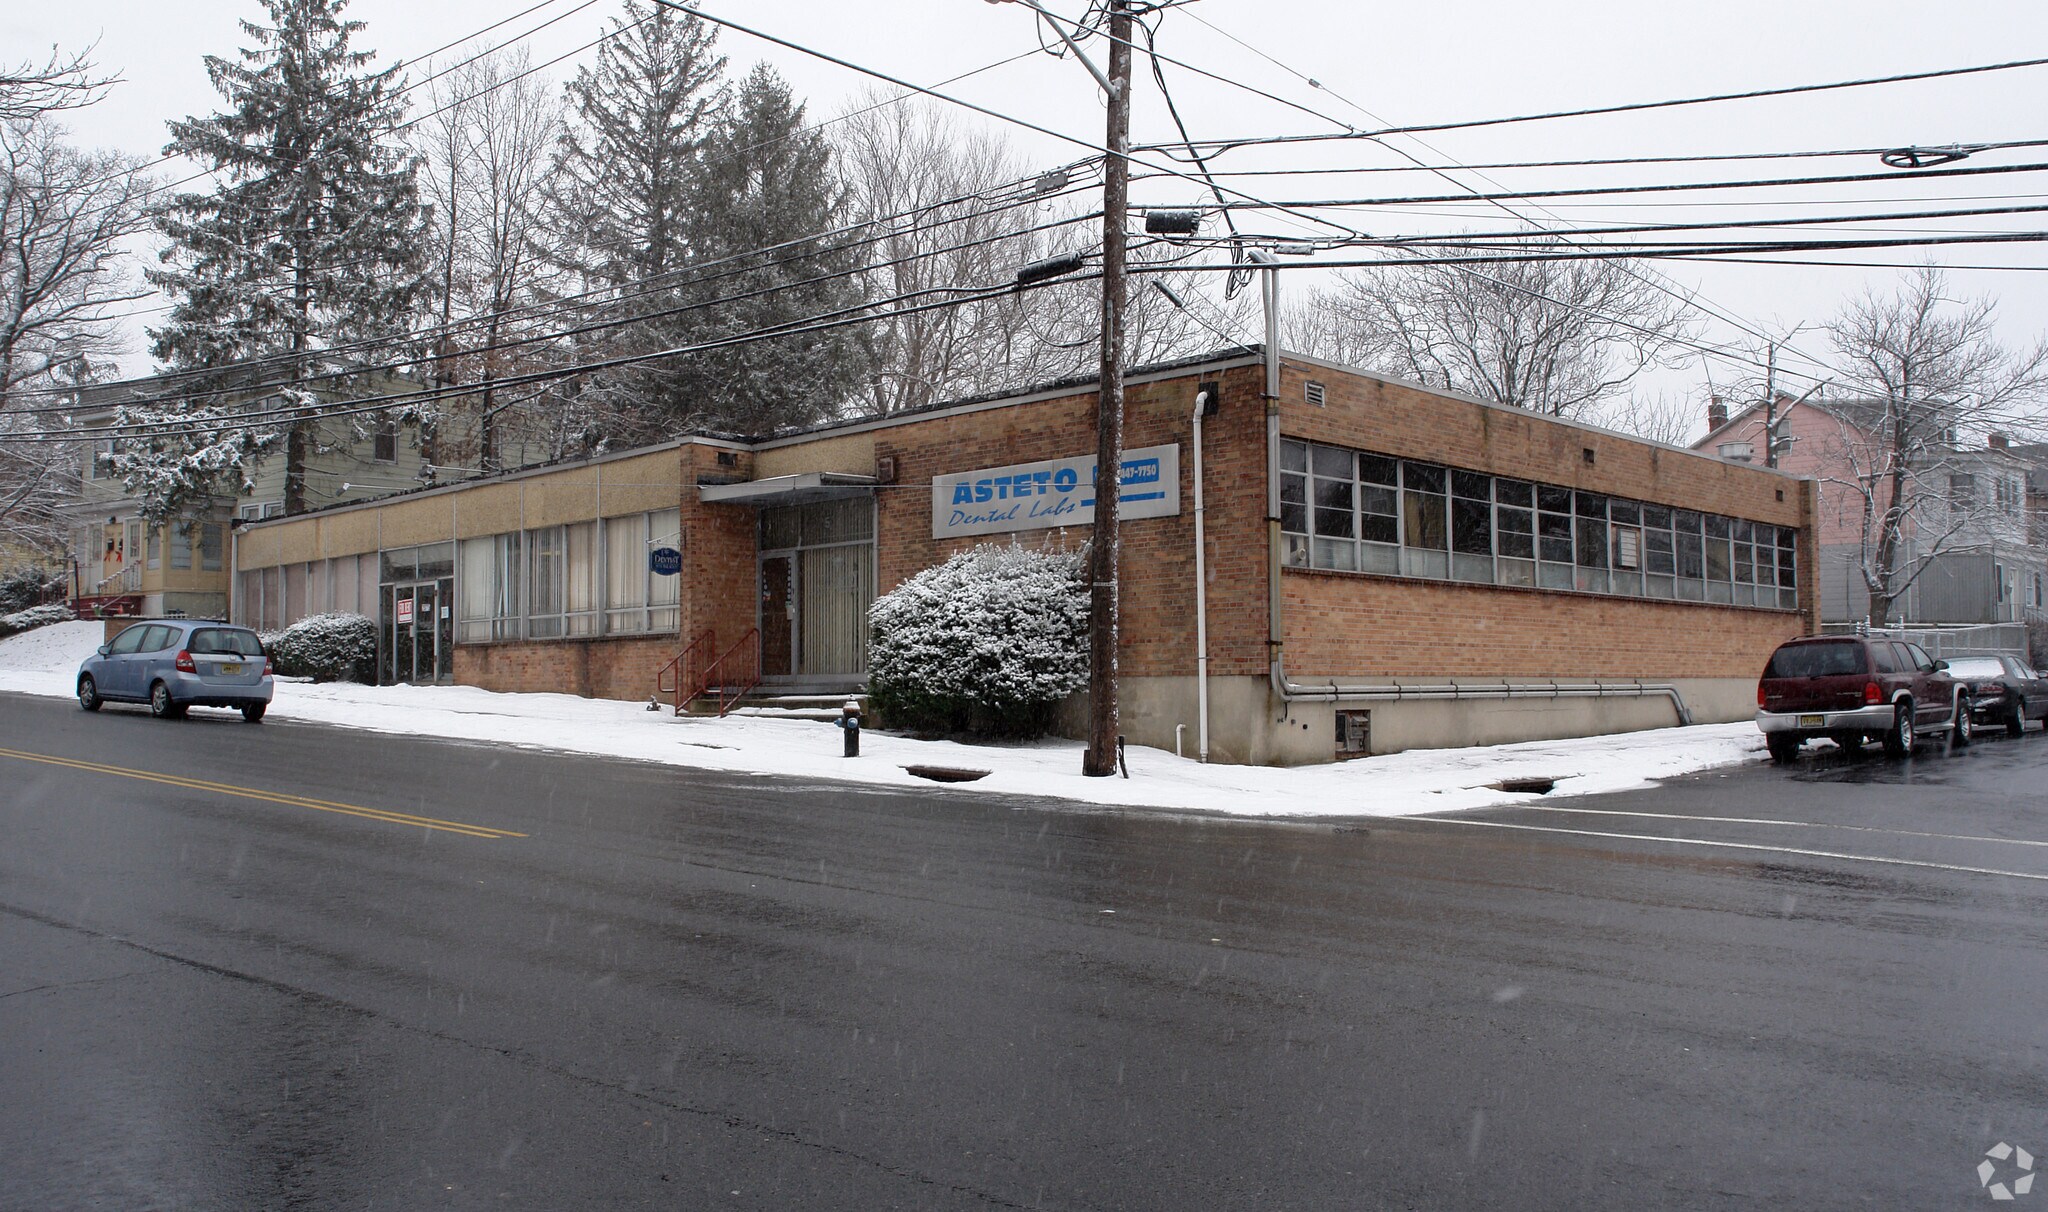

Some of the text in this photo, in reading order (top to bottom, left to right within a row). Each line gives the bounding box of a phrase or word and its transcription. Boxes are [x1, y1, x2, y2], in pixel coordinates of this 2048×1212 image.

[952, 468, 1078, 505] ASTETO
[948, 496, 1076, 527] Dental Labs
